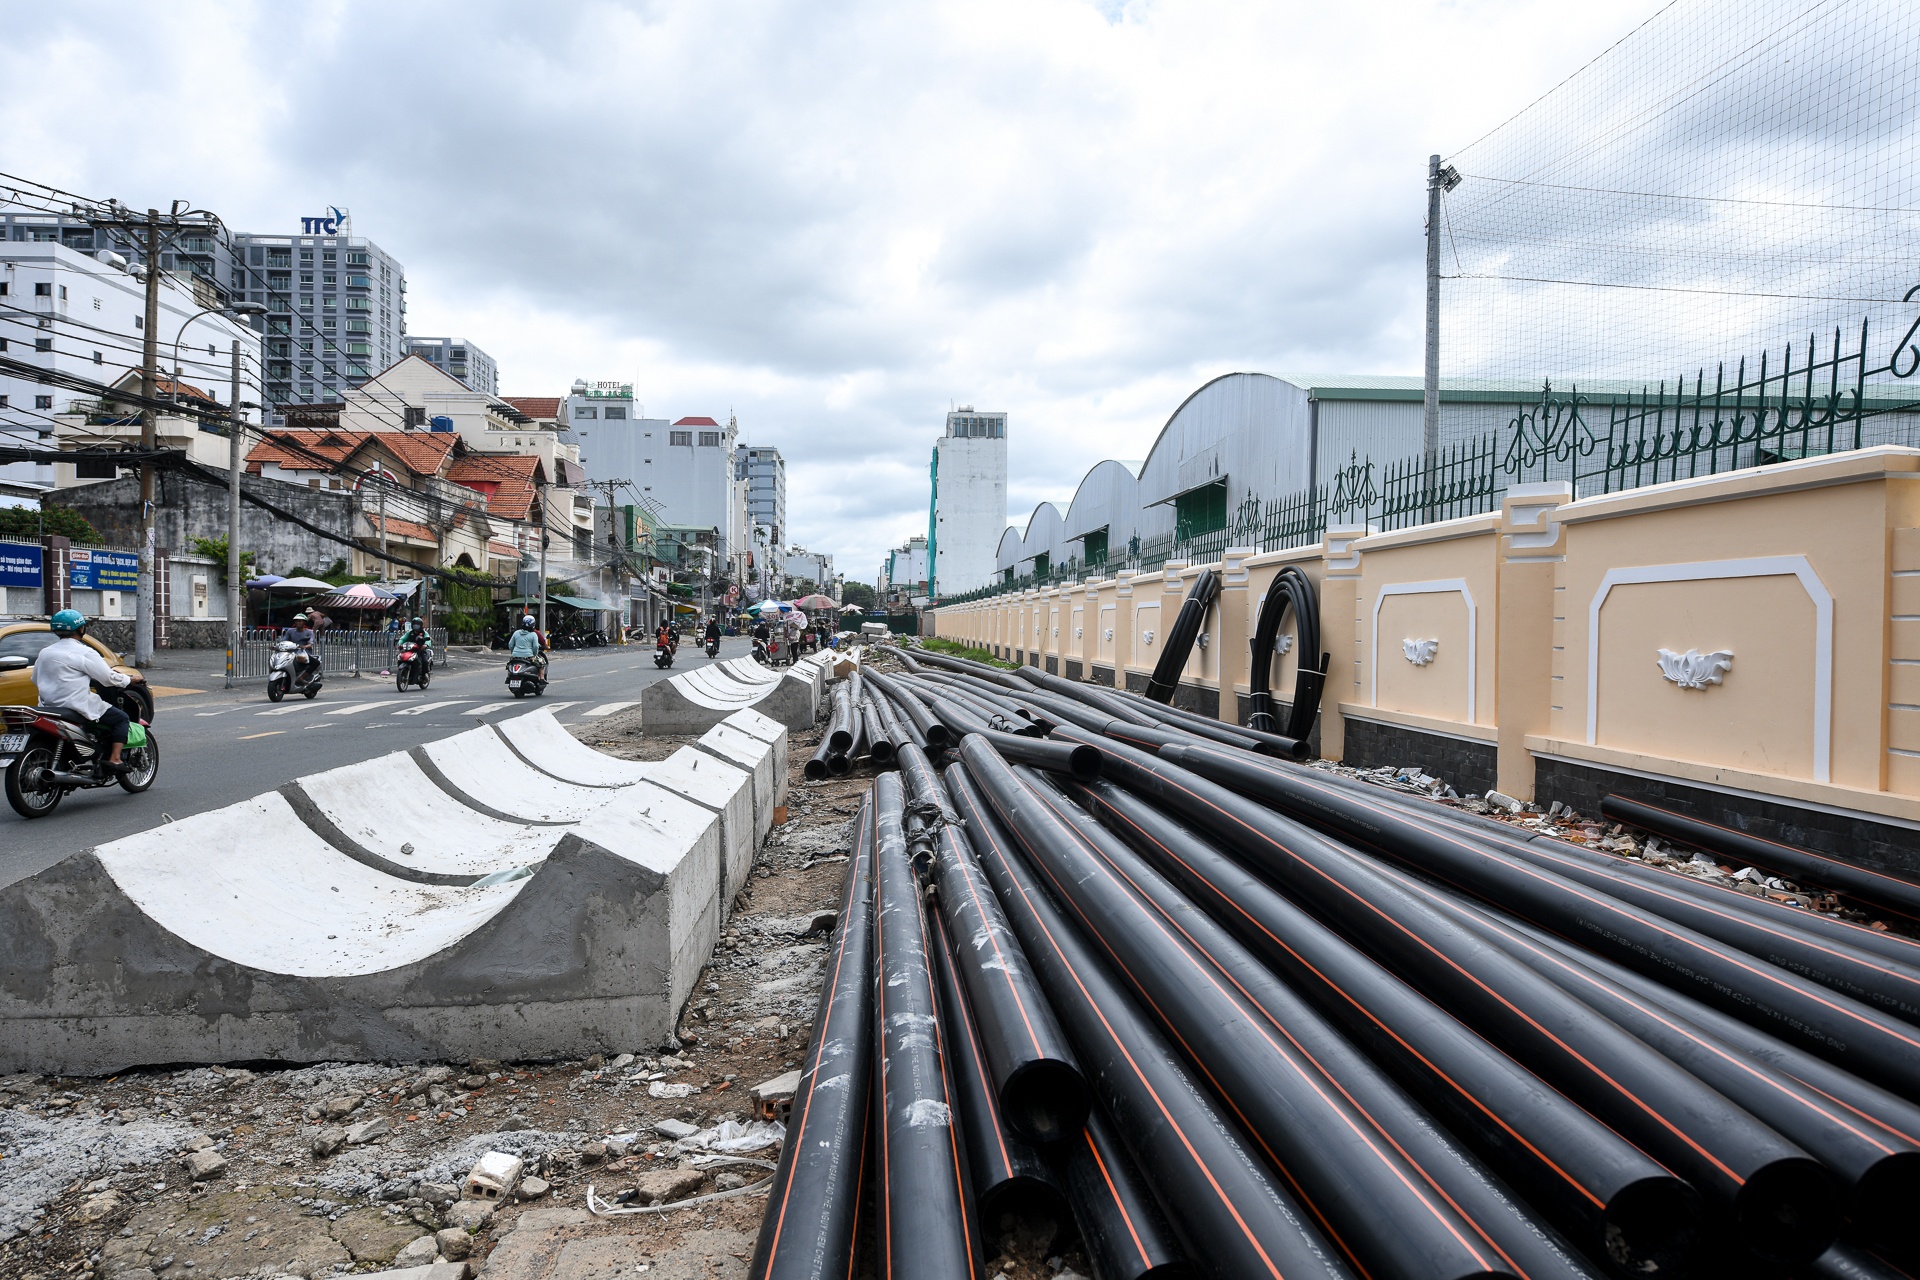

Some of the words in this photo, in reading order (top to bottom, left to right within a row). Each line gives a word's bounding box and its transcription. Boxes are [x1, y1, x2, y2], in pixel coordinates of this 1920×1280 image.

[301, 217, 337, 234] TTC
[597, 381, 620, 389] HOTEL
[1631, 944, 1648, 956] NGUY
[1662, 958, 1676, 969] CAO
[1676, 966, 1695, 977] NGAM
[1695, 974, 1709, 985] CAP
[1769, 954, 1786, 966] ONG
[1788, 962, 1810, 975] HDPE
[1812, 970, 1826, 980] 200
[1835, 978, 1864, 995] 14.7mm
[1872, 992, 1898, 1006] CTCP
[1713, 982, 1732, 995] BAAN
[1732, 992, 1752, 1005] CTCP
[1756, 1004, 1782, 1020] 14.7mm
[1789, 1019, 1804, 1030] 200
[1804, 1026, 1826, 1041] HDPE
[1827, 1036, 1846, 1051] ONG
[830, 1151, 839, 1164] CAP
[827, 1163, 837, 1181] NGAM
[825, 1181, 834, 1195] CAO
[1482, 1182, 1509, 1203] NGUY
[818, 1209, 830, 1230] NGUY
[1525, 1222, 1546, 1239] CAO
[812, 1248, 824, 1270] CHET
